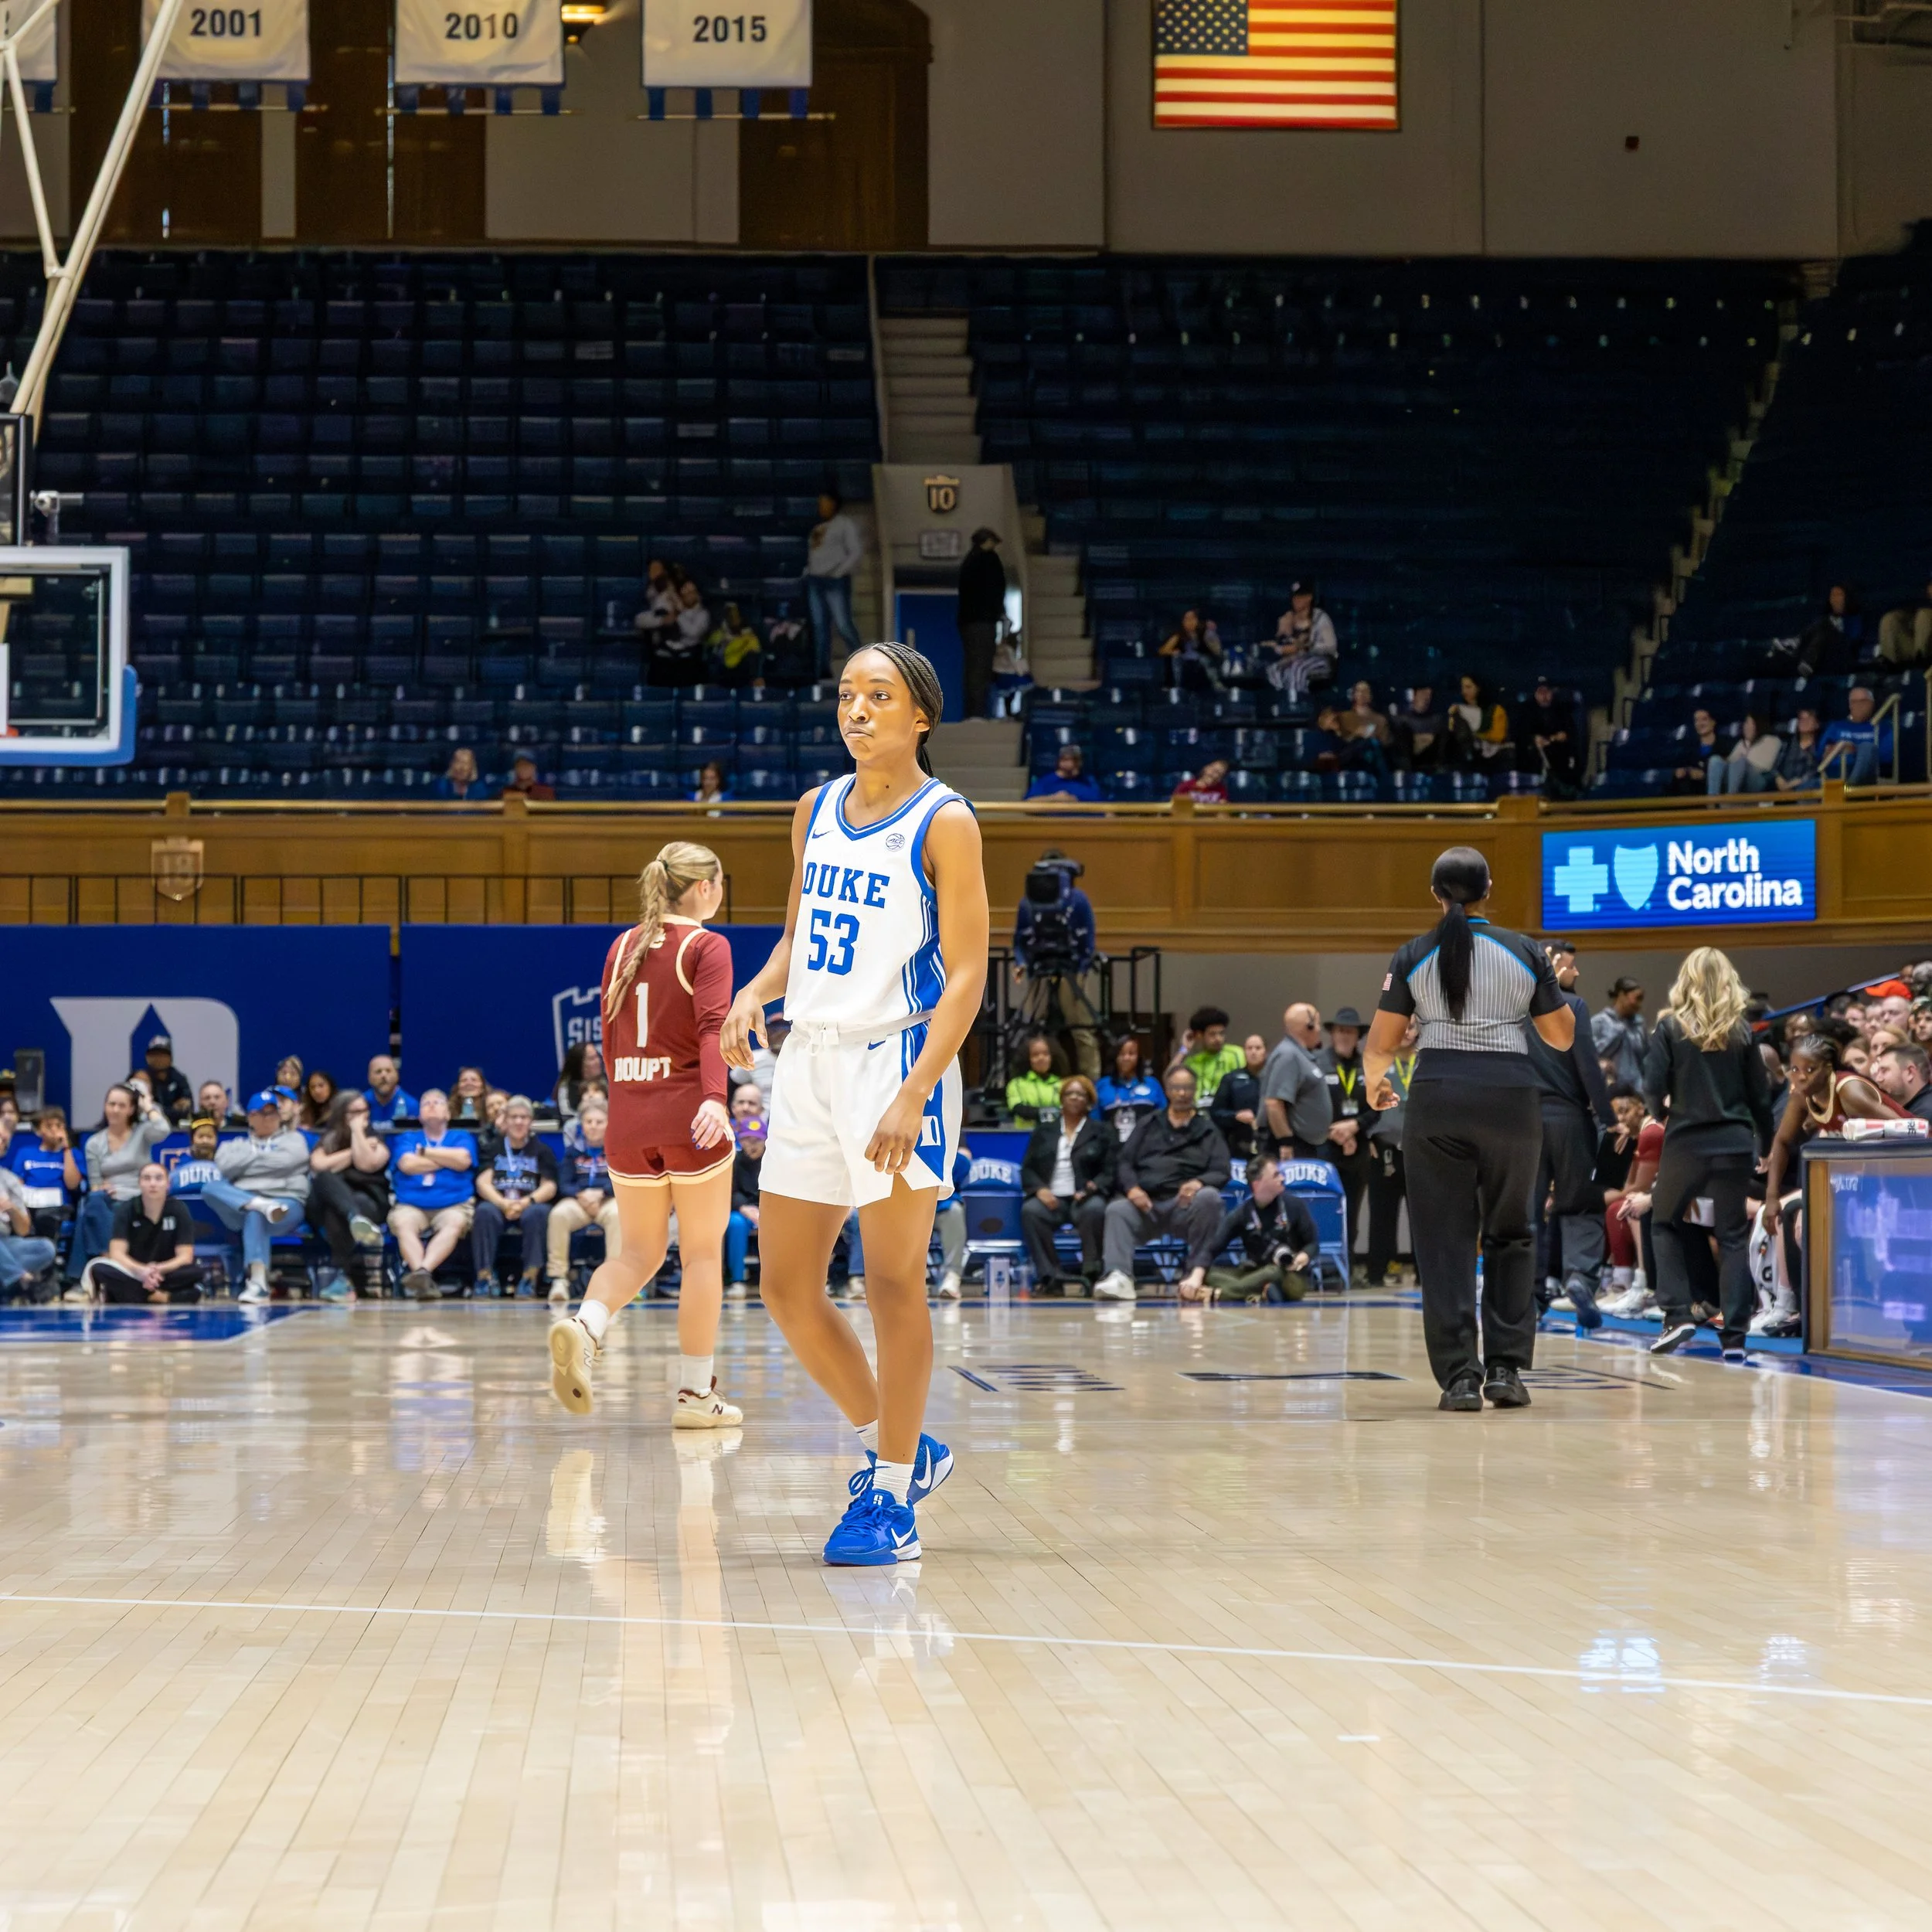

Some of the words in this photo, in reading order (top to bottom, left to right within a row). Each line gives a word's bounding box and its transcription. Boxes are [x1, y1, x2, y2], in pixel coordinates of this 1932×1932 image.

[191, 9, 261, 36] 2001
[445, 12, 519, 41] 2010
[693, 15, 767, 43] 2015
[930, 487, 955, 512] 10
[1668, 838, 1760, 876] North
[801, 862, 890, 908] DUKE
[1667, 872, 1802, 911] Carolina
[808, 908, 859, 975] 53
[635, 982, 649, 1048] 1
[614, 1056, 672, 1083] HOUPT
[1284, 1163, 1328, 1186] DUKE
